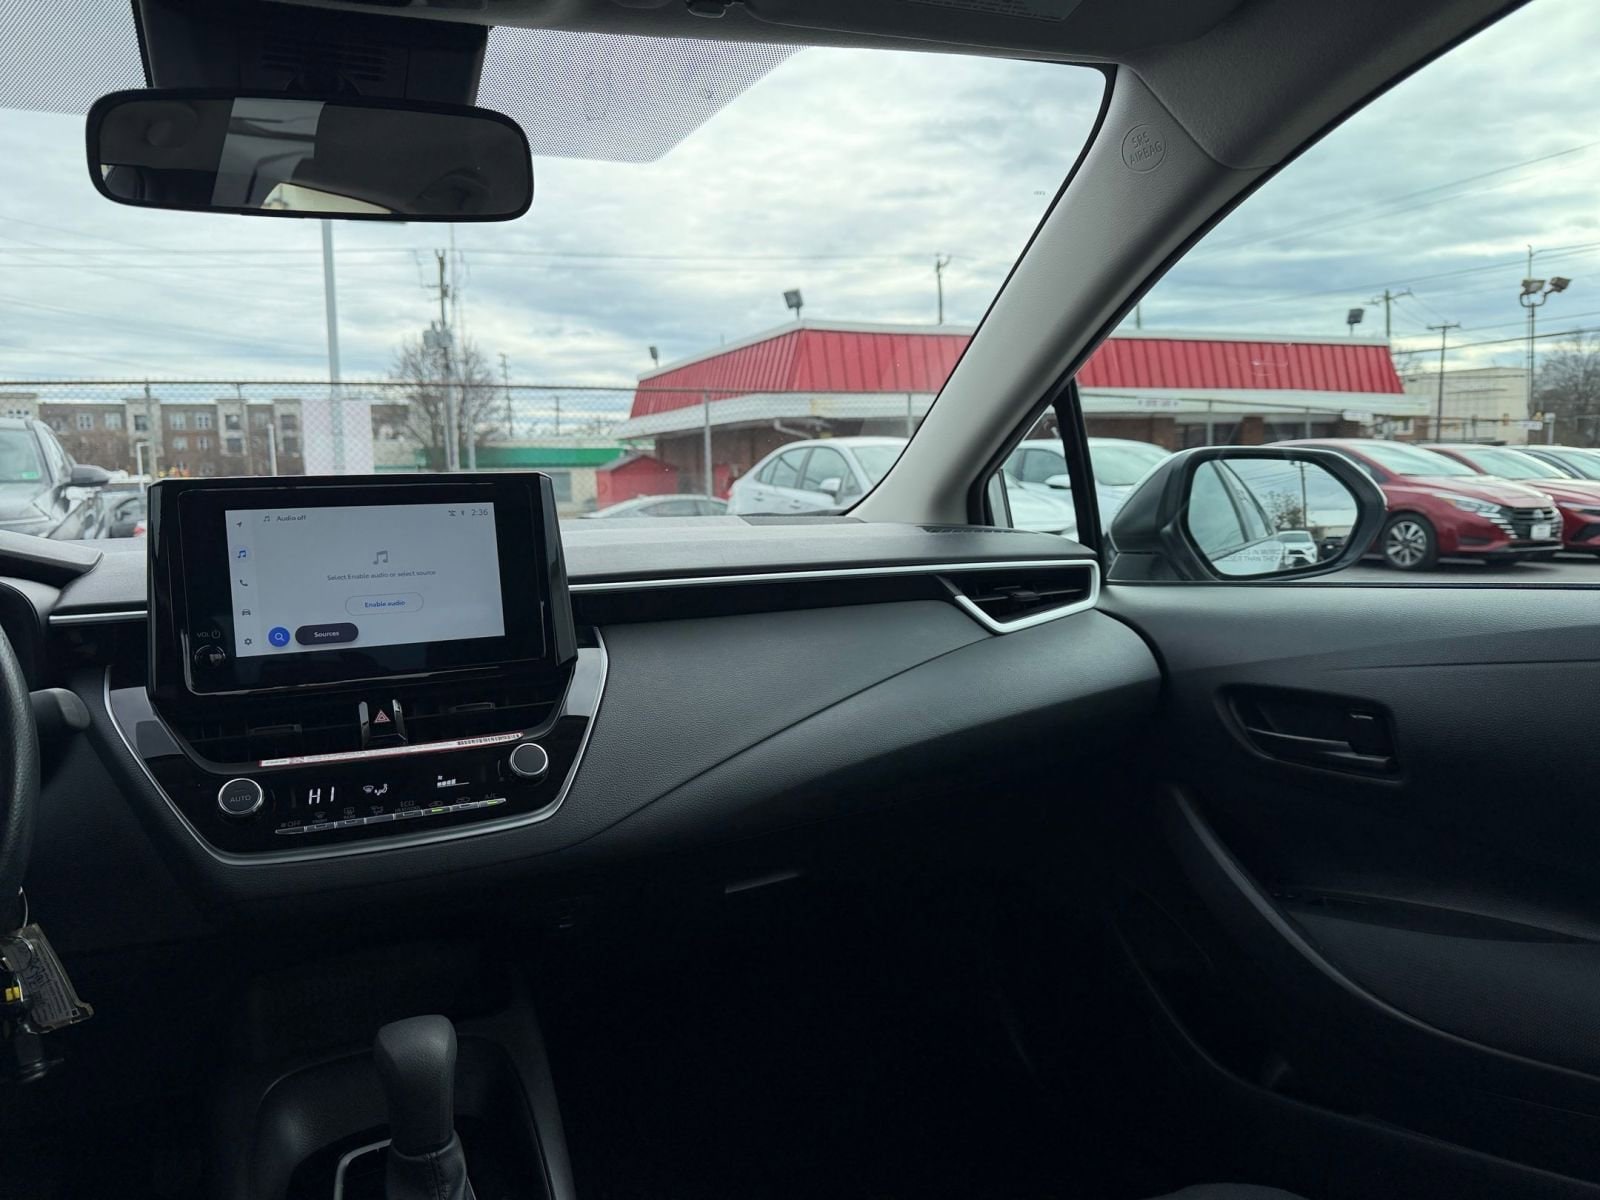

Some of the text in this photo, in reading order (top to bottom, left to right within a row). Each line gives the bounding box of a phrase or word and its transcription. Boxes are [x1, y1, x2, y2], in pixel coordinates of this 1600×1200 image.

[1131, 131, 1150, 149] SRS
[1129, 141, 1163, 166] AIRBAG
[471, 508, 489, 516] 2:36
[313, 630, 340, 638] Sources
[229, 794, 252, 803] AUTO
